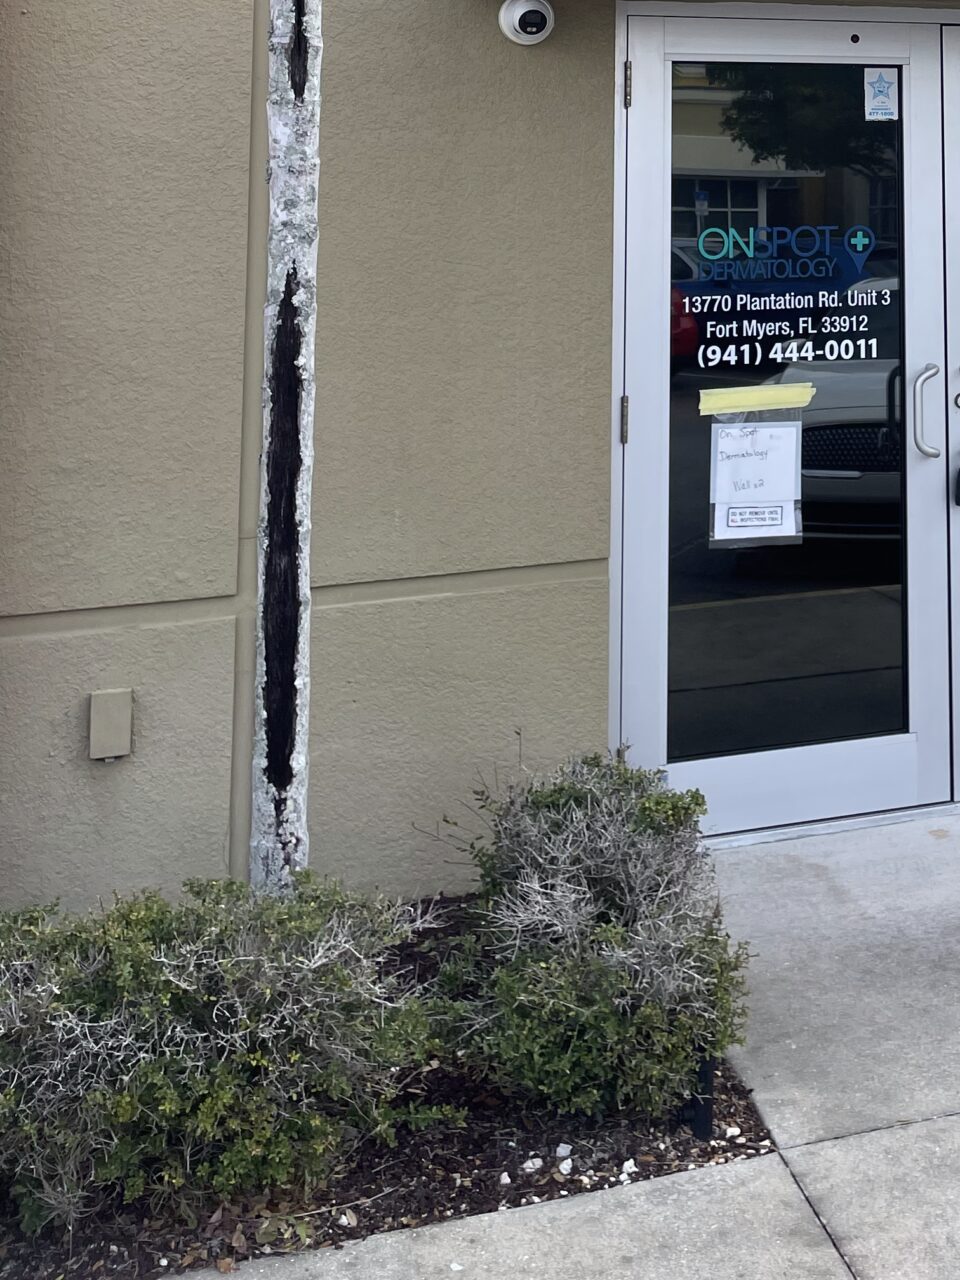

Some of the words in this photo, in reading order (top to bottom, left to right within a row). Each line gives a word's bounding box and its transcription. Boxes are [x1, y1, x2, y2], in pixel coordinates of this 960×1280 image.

[698, 225, 839, 260] ONSPOT
[698, 257, 837, 281] DERMATOLOGY
[682, 295, 732, 313] 13770
[737, 292, 814, 311] Plantation
[818, 291, 843, 308] Rd.
[848, 290, 877, 306] Unit
[881, 289, 891, 305] 3
[706, 321, 738, 338] Fort
[743, 320, 795, 340] Myers,
[799, 317, 817, 334] FL
[821, 315, 868, 333] 33912
[698, 342, 762, 368] (941)
[769, 338, 878, 363] 444-0011
